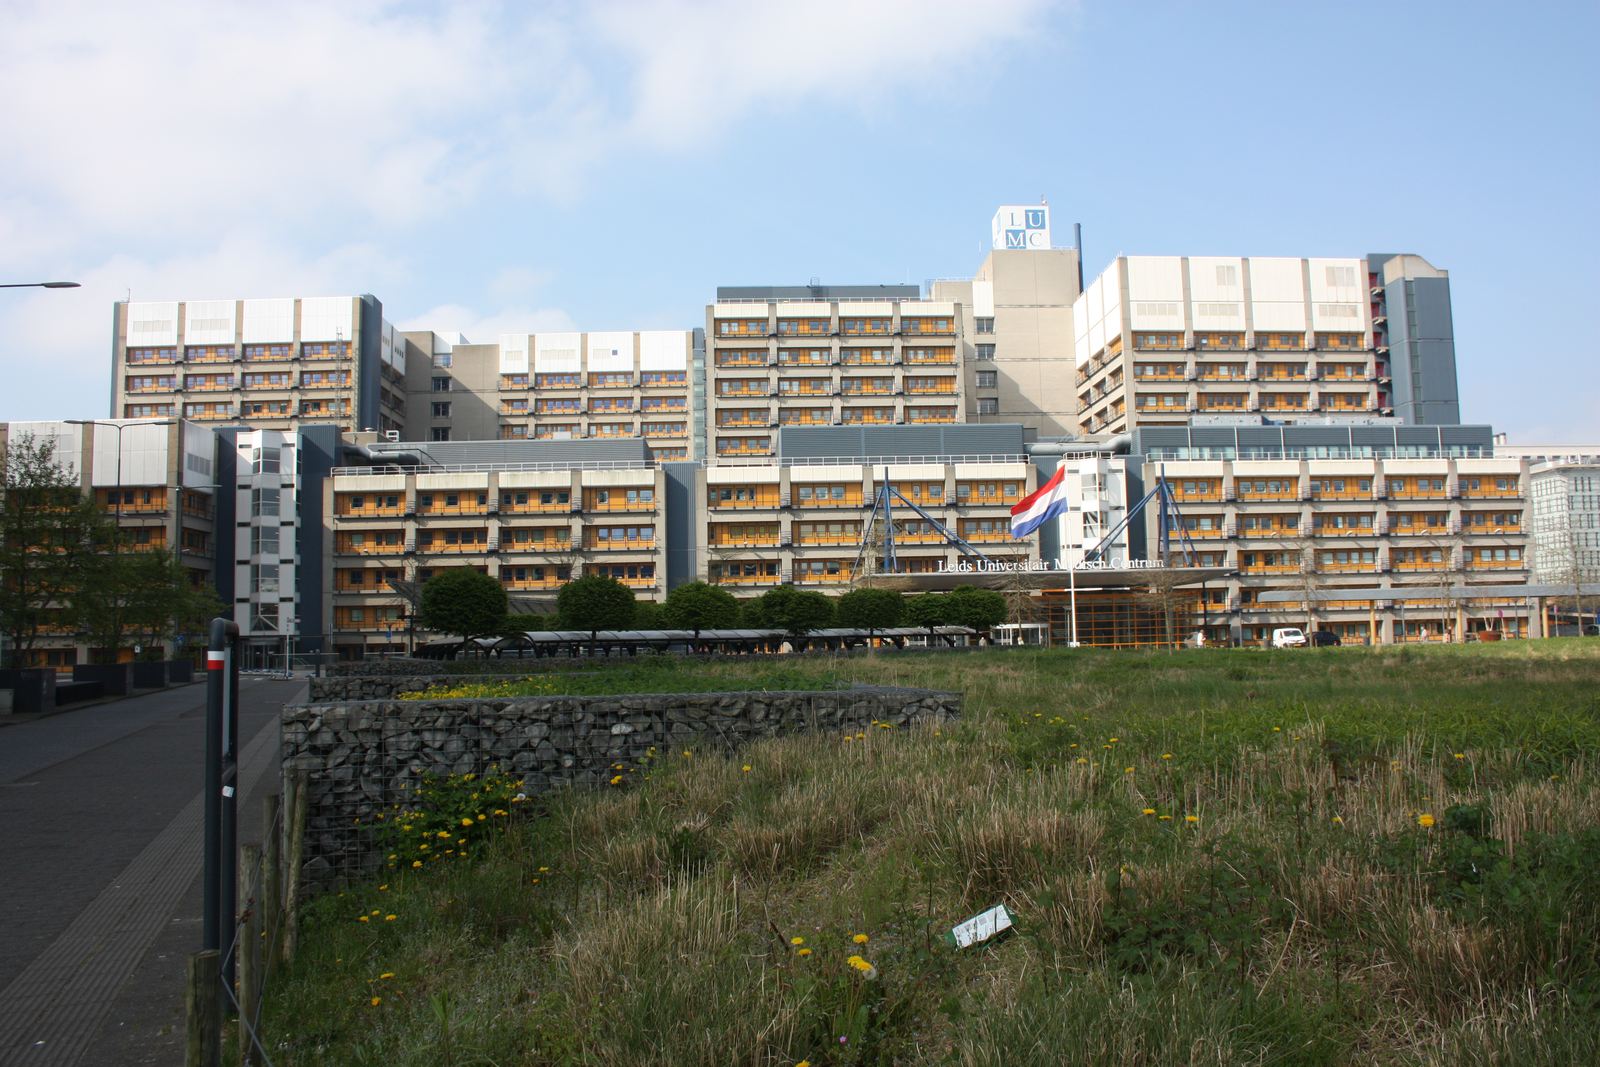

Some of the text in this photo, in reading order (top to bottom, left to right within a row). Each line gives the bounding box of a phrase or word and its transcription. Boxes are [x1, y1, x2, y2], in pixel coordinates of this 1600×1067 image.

[938, 560, 973, 573] Leids
[976, 559, 1050, 572] Universitair
[1110, 557, 1165, 570] Centrum
